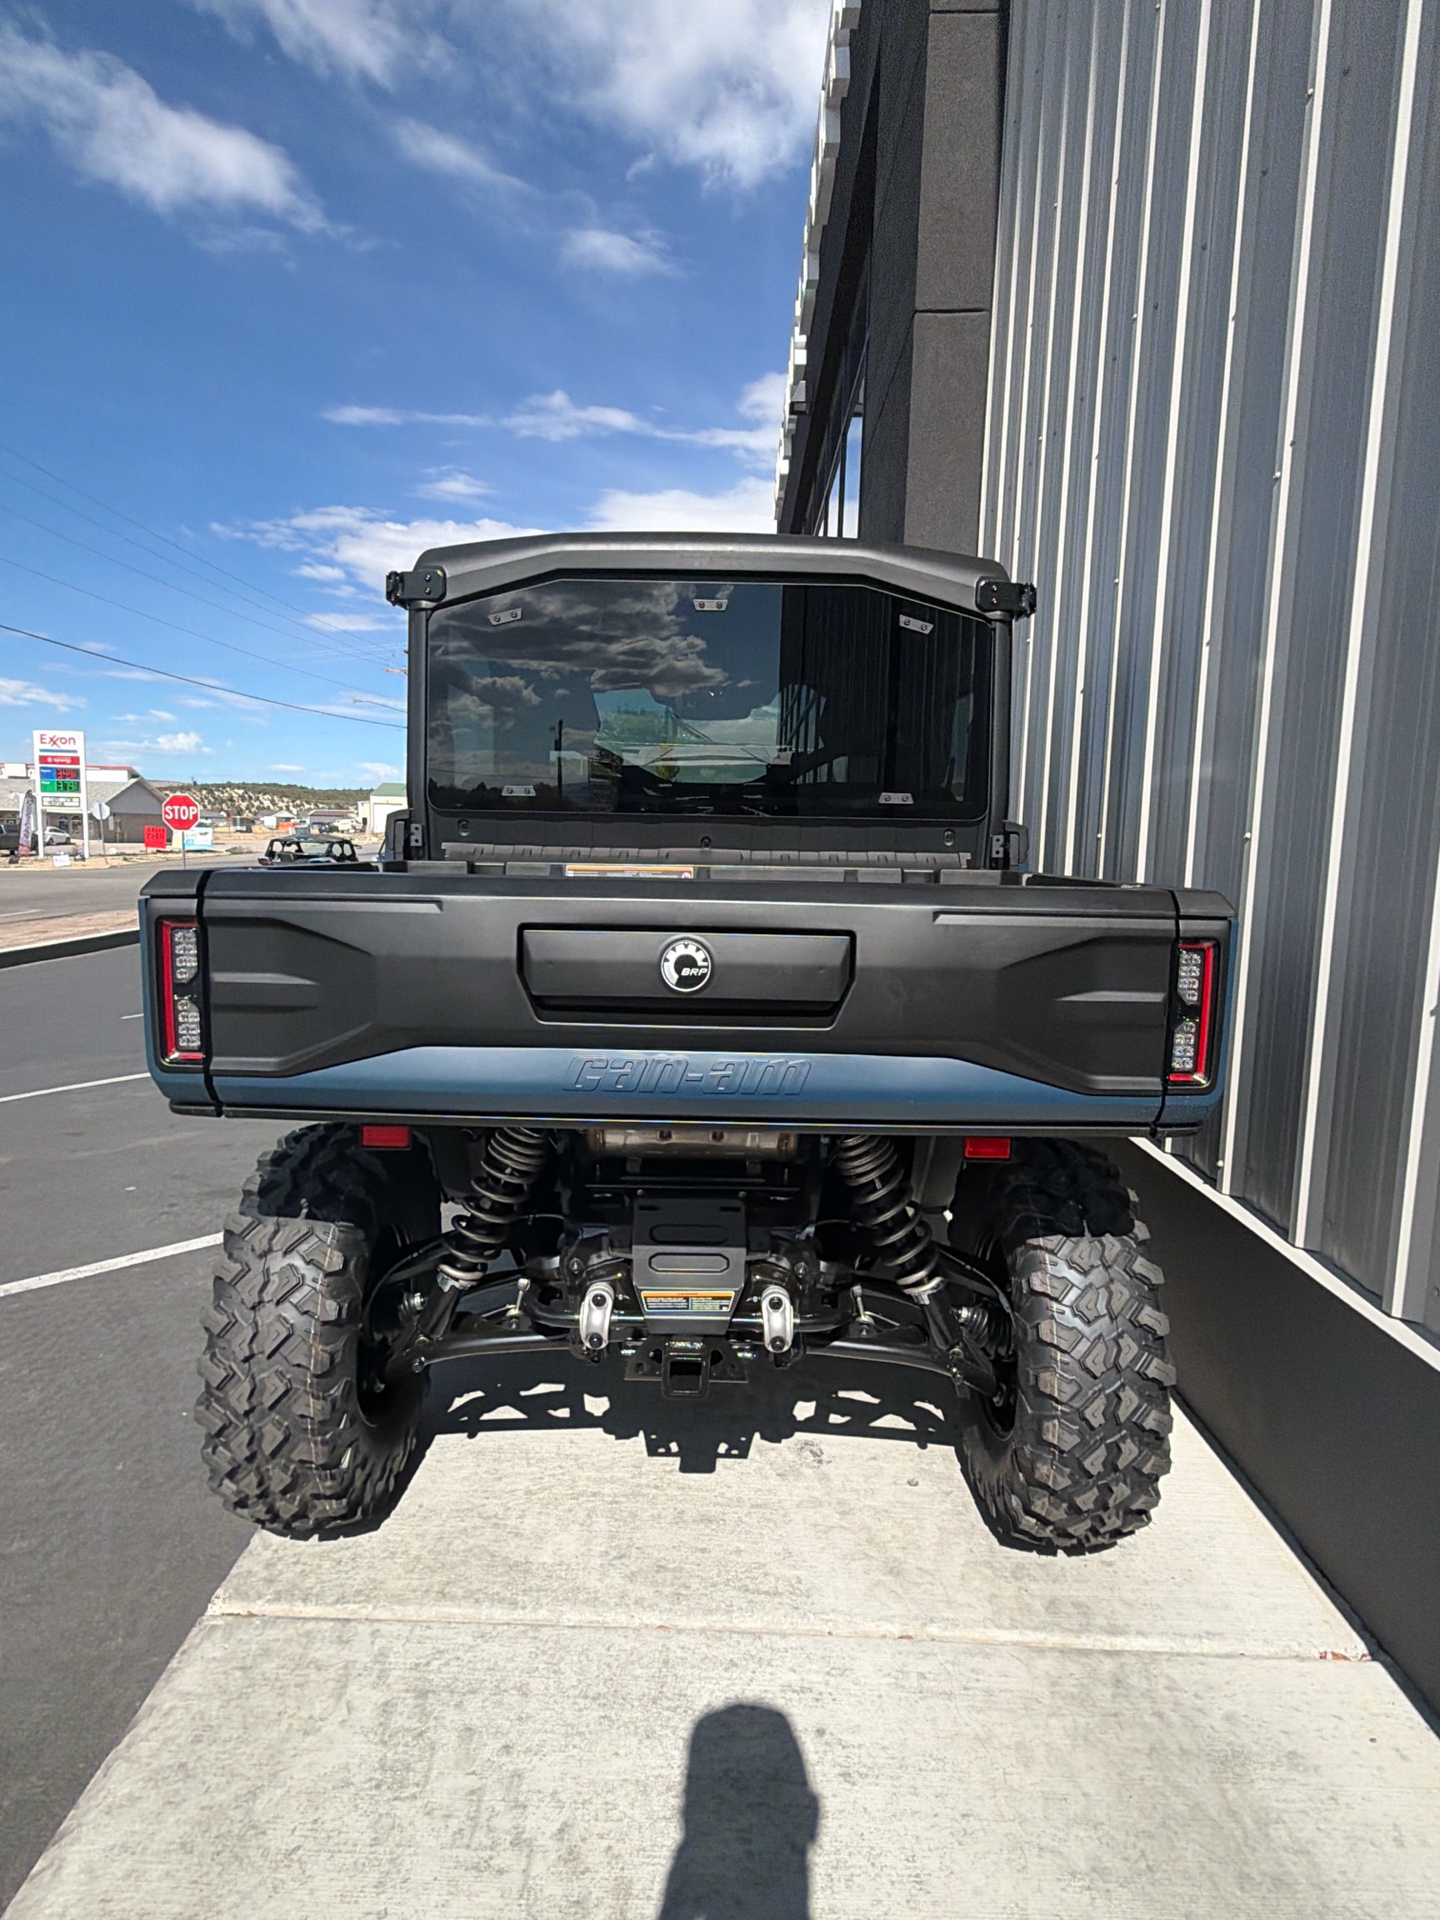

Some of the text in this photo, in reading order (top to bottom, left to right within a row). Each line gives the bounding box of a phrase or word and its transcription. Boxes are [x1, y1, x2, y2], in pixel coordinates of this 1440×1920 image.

[40, 733, 76, 748] Exxon
[165, 805, 197, 820] STOP
[681, 967, 707, 976] BRP
